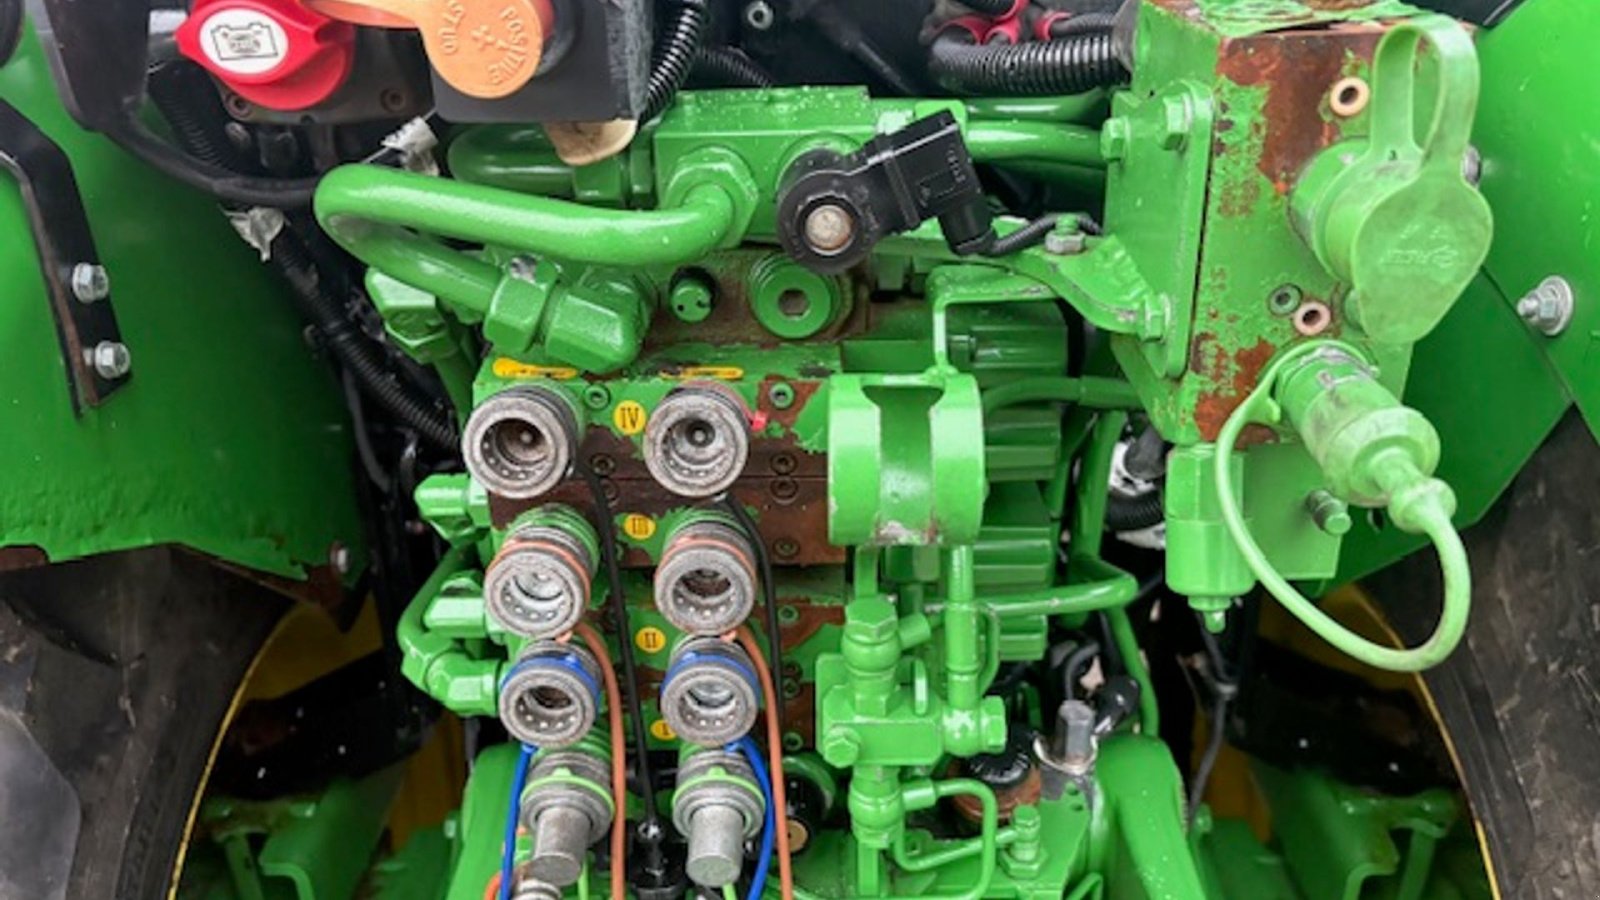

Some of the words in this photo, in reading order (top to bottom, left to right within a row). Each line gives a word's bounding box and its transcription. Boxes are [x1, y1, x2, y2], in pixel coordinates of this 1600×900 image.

[486, 5, 528, 85] POSITIVE
[620, 406, 640, 430] IV
[631, 516, 649, 536] III
[643, 631, 658, 649] II
